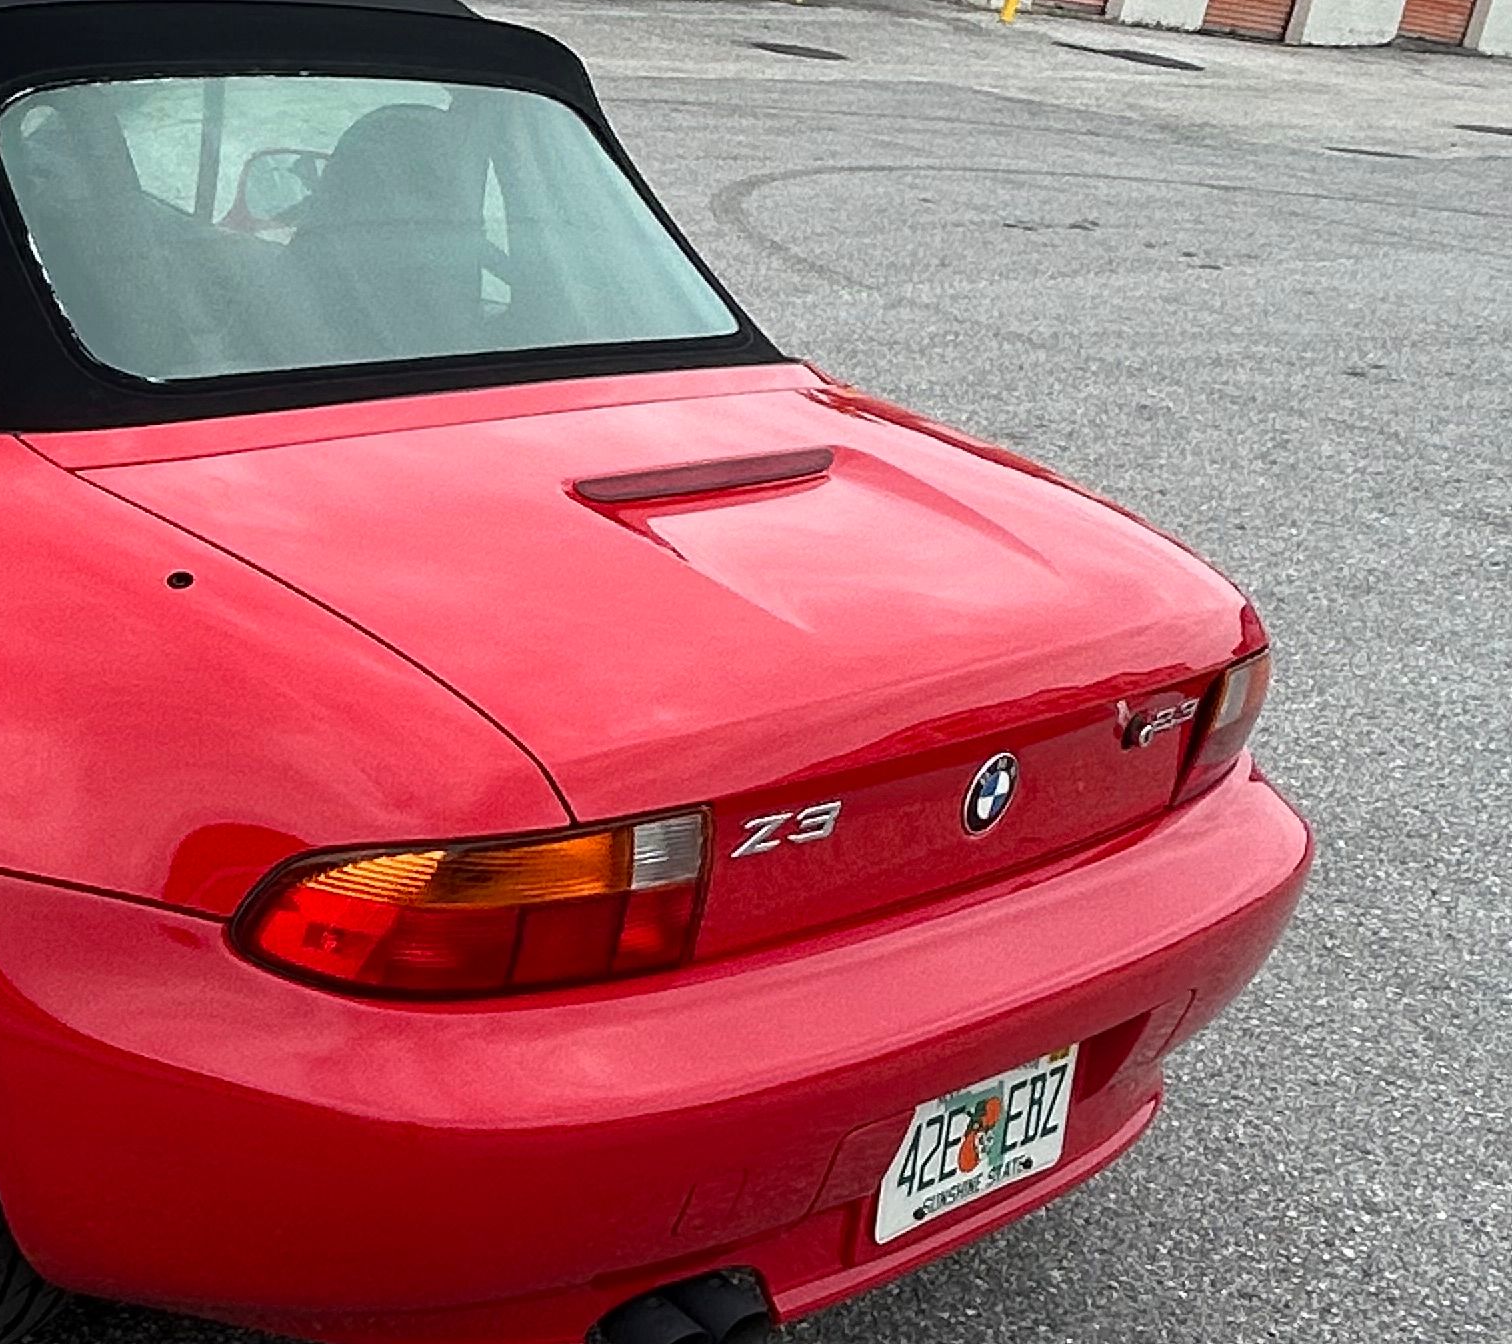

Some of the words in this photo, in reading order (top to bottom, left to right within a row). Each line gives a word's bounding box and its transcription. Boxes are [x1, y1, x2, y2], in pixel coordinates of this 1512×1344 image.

[731, 800, 842, 858] Z3
[896, 1105, 967, 1197] 42E
[1000, 1063, 1069, 1155] EBZ
[923, 1171, 983, 1214] SUNSHINE
